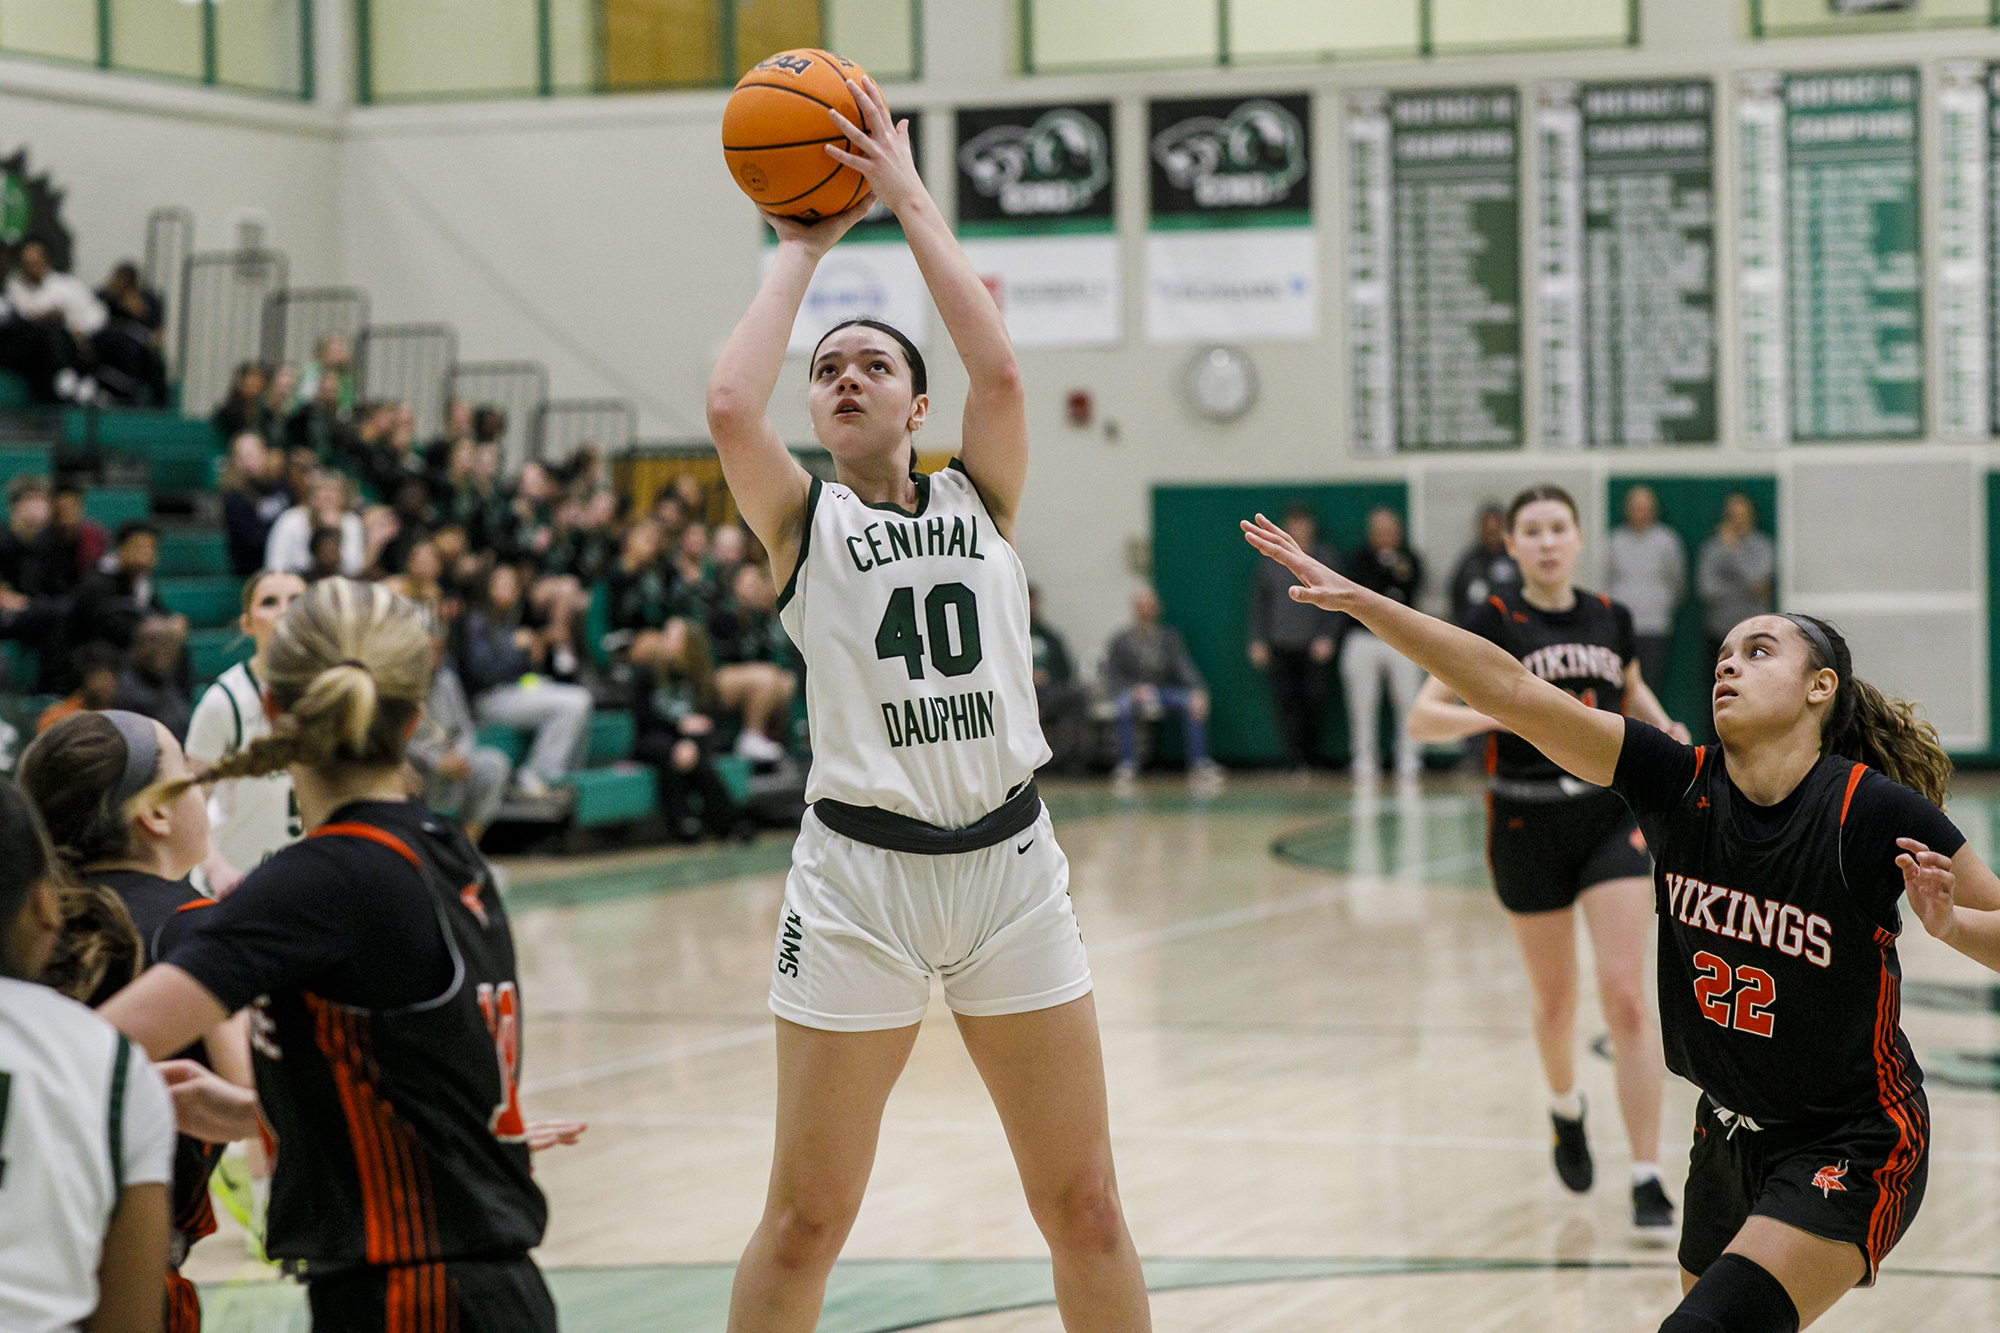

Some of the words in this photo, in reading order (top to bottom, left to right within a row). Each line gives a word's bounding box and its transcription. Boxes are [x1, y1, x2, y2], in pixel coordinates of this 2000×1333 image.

[752, 54, 815, 76] CAA
[846, 514, 985, 573] CENTRAL
[875, 582, 983, 680] 40
[881, 691, 995, 748] DAUPHIN
[778, 909, 802, 979] RAMS
[1665, 872, 1833, 969] VIKINGS
[1693, 950, 1777, 1038] 22
